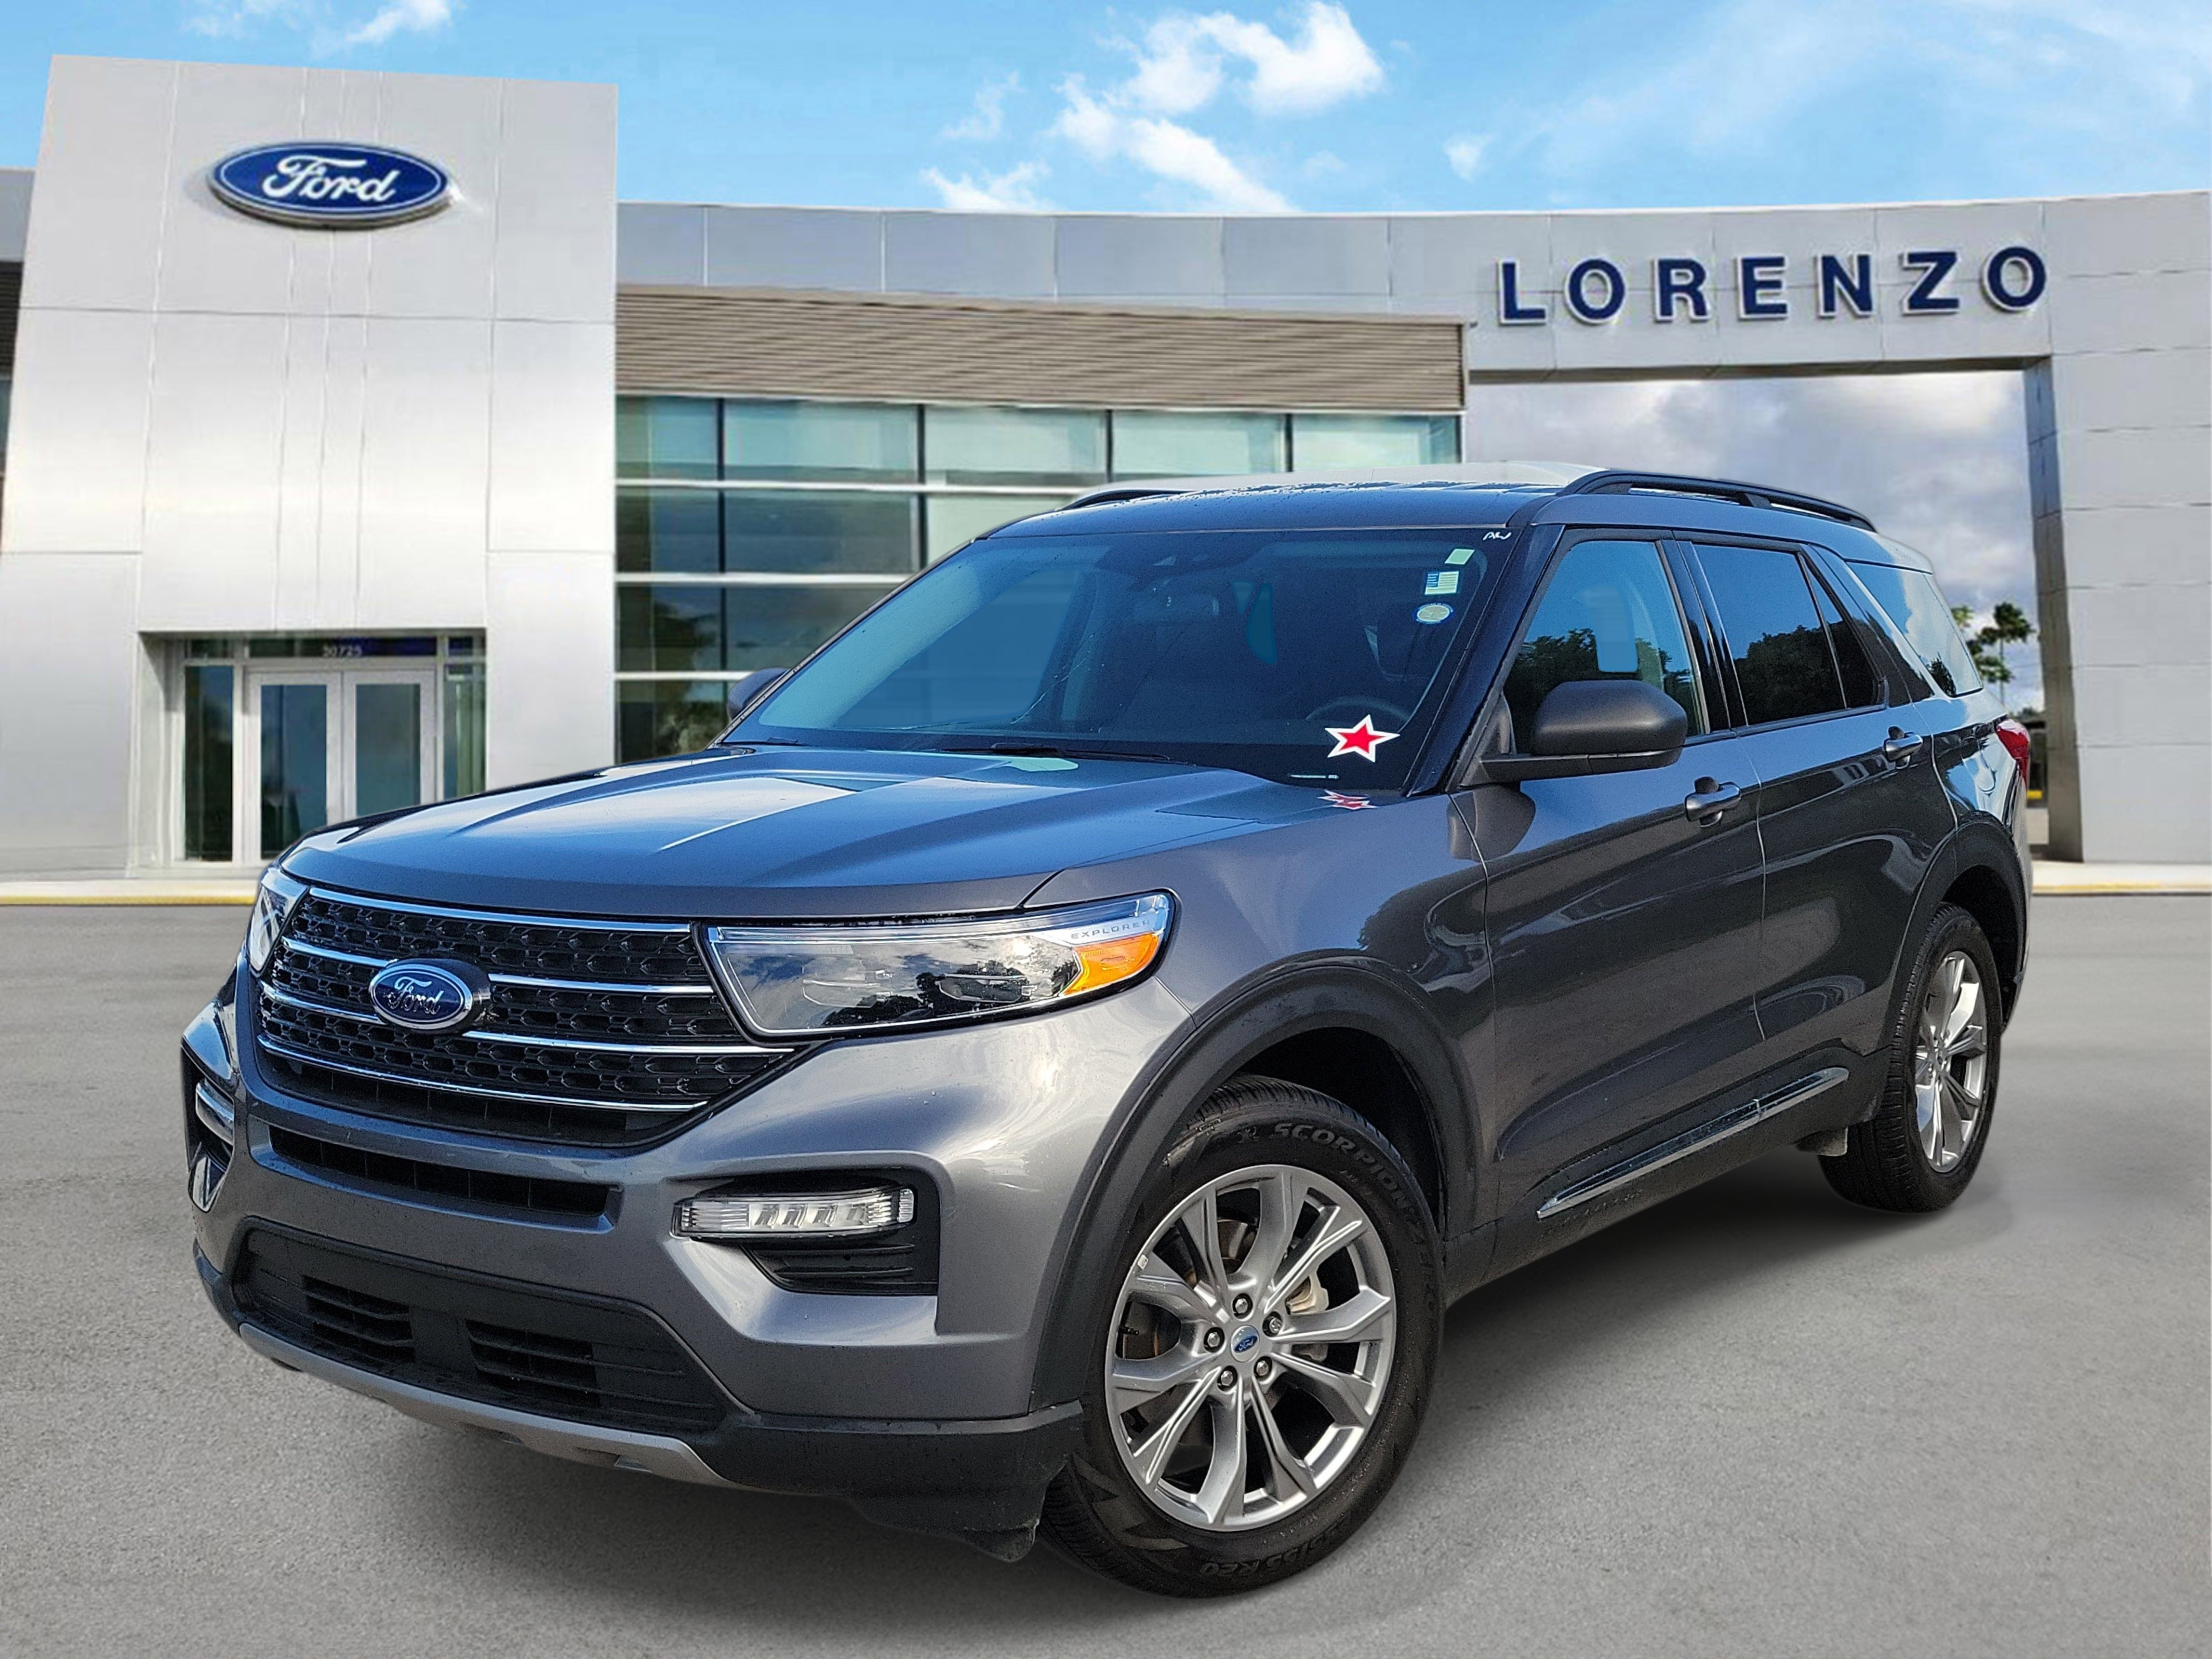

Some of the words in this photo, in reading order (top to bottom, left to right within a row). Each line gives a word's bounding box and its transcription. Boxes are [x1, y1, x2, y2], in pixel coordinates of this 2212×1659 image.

[262, 154, 400, 201] Ford
[1497, 246, 2047, 324] LORENZO
[1070, 920, 1151, 939] EXPLORER
[386, 976, 444, 1015] Ford
[1269, 1123, 1413, 1208] SCORPION
